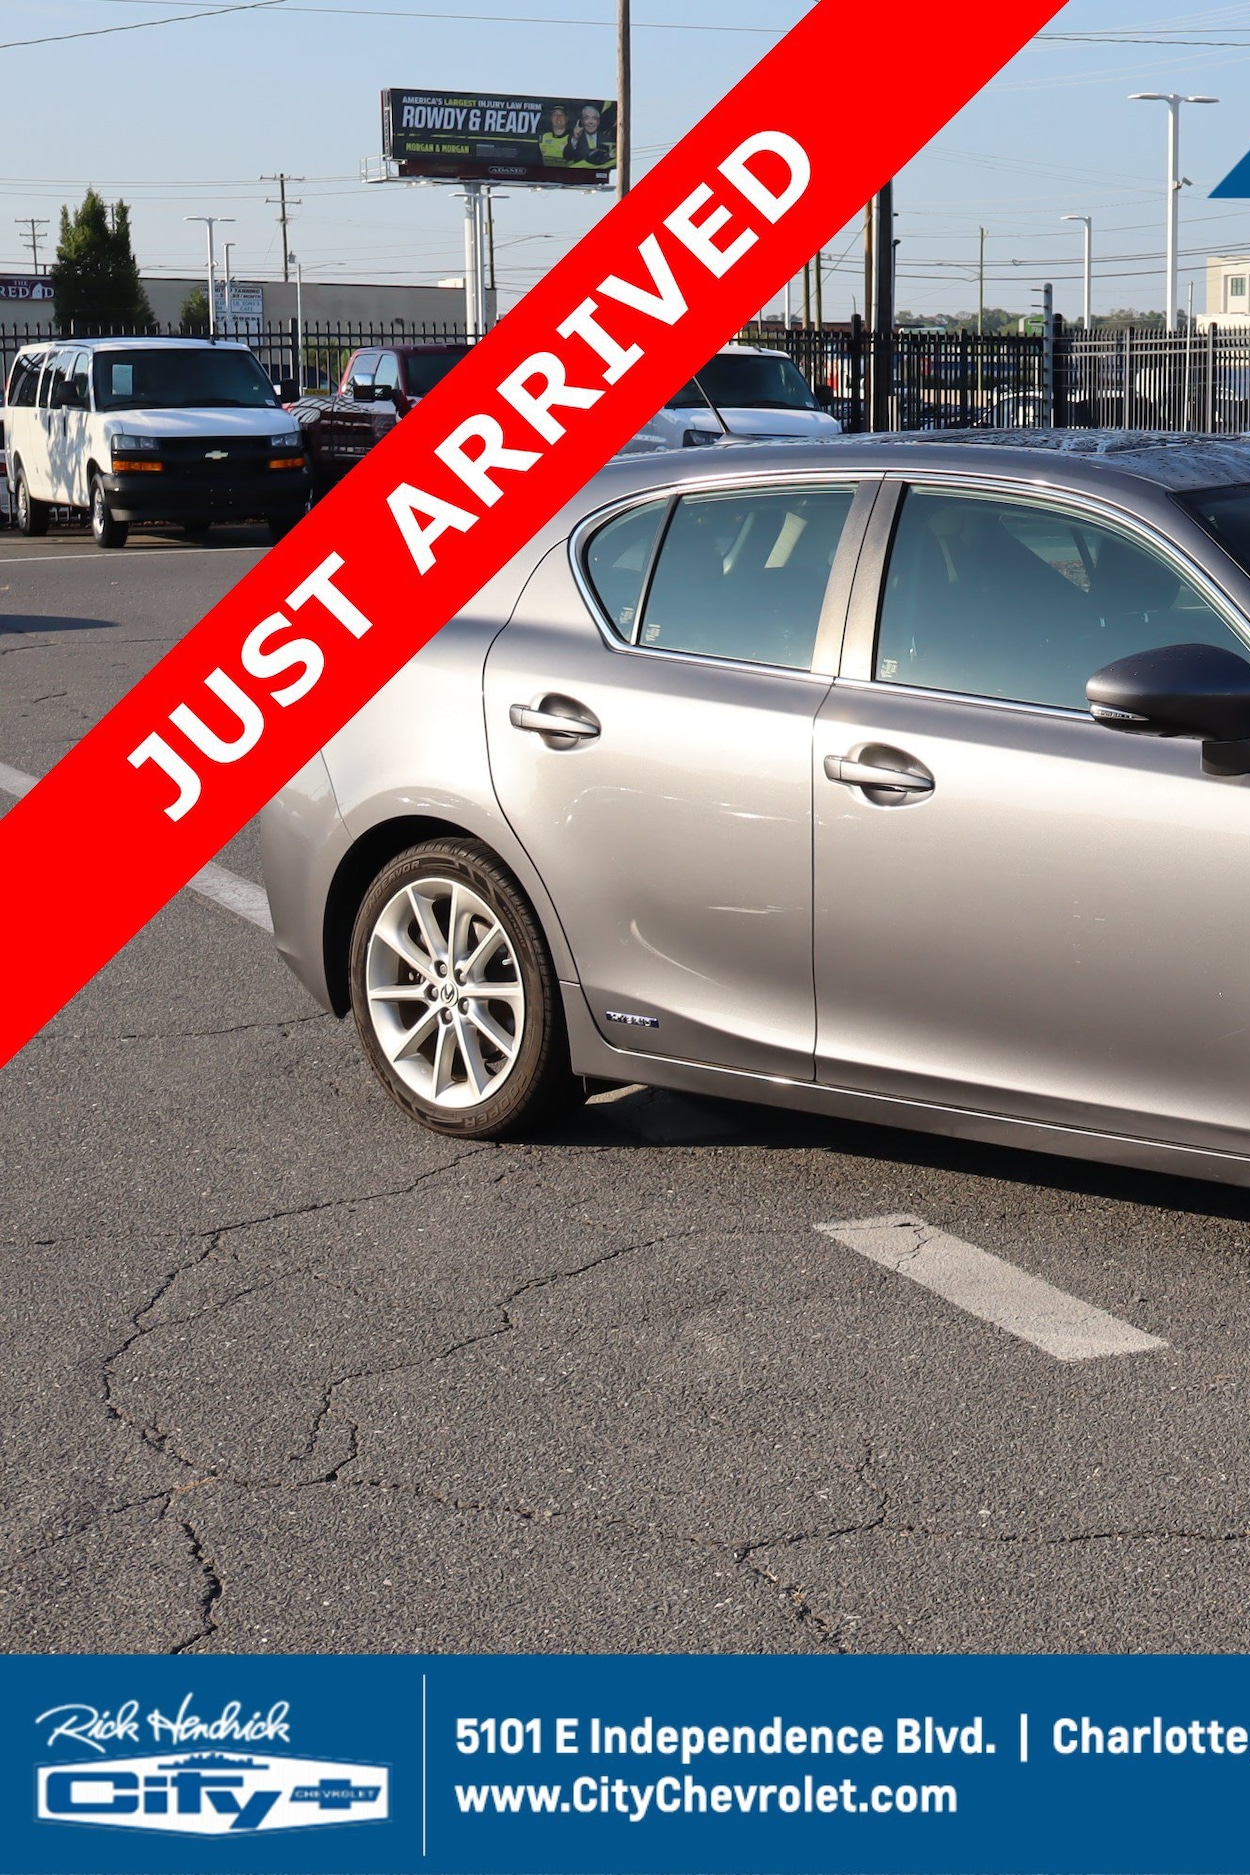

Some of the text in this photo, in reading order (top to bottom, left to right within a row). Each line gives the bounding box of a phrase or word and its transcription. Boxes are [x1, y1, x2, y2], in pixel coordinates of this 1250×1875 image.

[402, 96, 542, 111] AMERICA'S LARGEST INJURY LAW FIRM
[402, 105, 541, 134] ROWDY & READY
[406, 142, 433, 153] MORGAN
[442, 143, 469, 154] MORGAN
